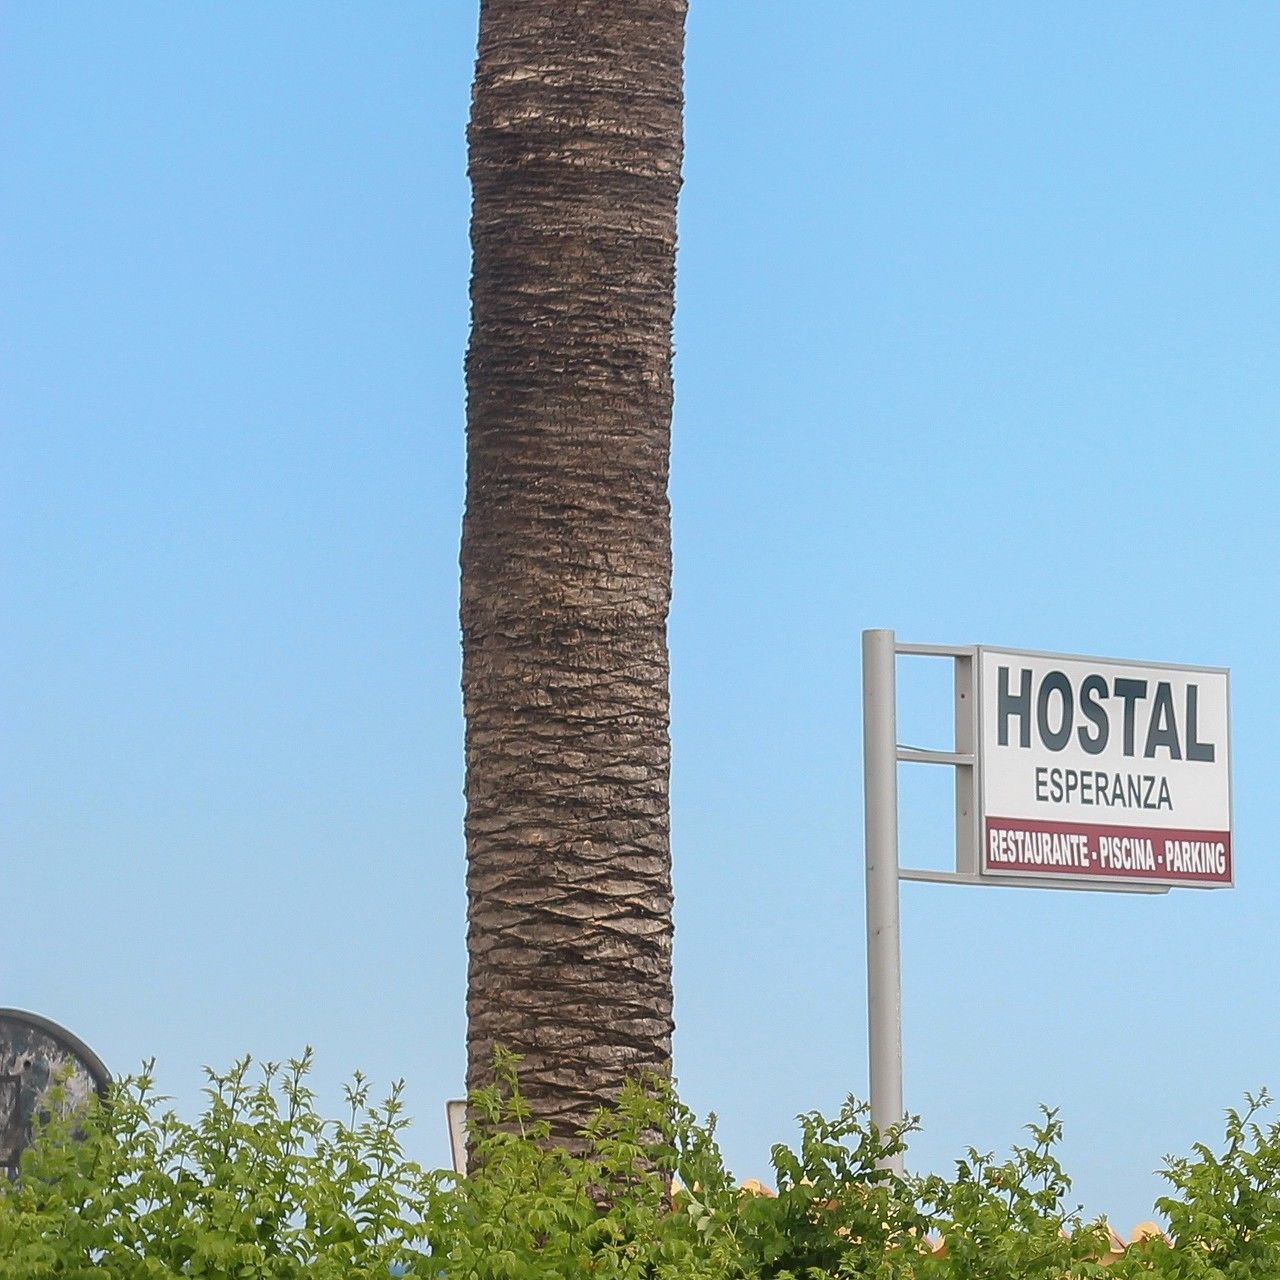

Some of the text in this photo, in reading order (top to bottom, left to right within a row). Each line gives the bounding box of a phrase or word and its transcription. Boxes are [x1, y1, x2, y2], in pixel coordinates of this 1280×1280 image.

[997, 666, 1215, 763] HOSTAL
[1035, 767, 1173, 811] ESPERANZA
[989, 828, 1090, 867] RESTAURANTE
[1099, 836, 1156, 871] PISCINA
[1164, 840, 1226, 875] PARKING
